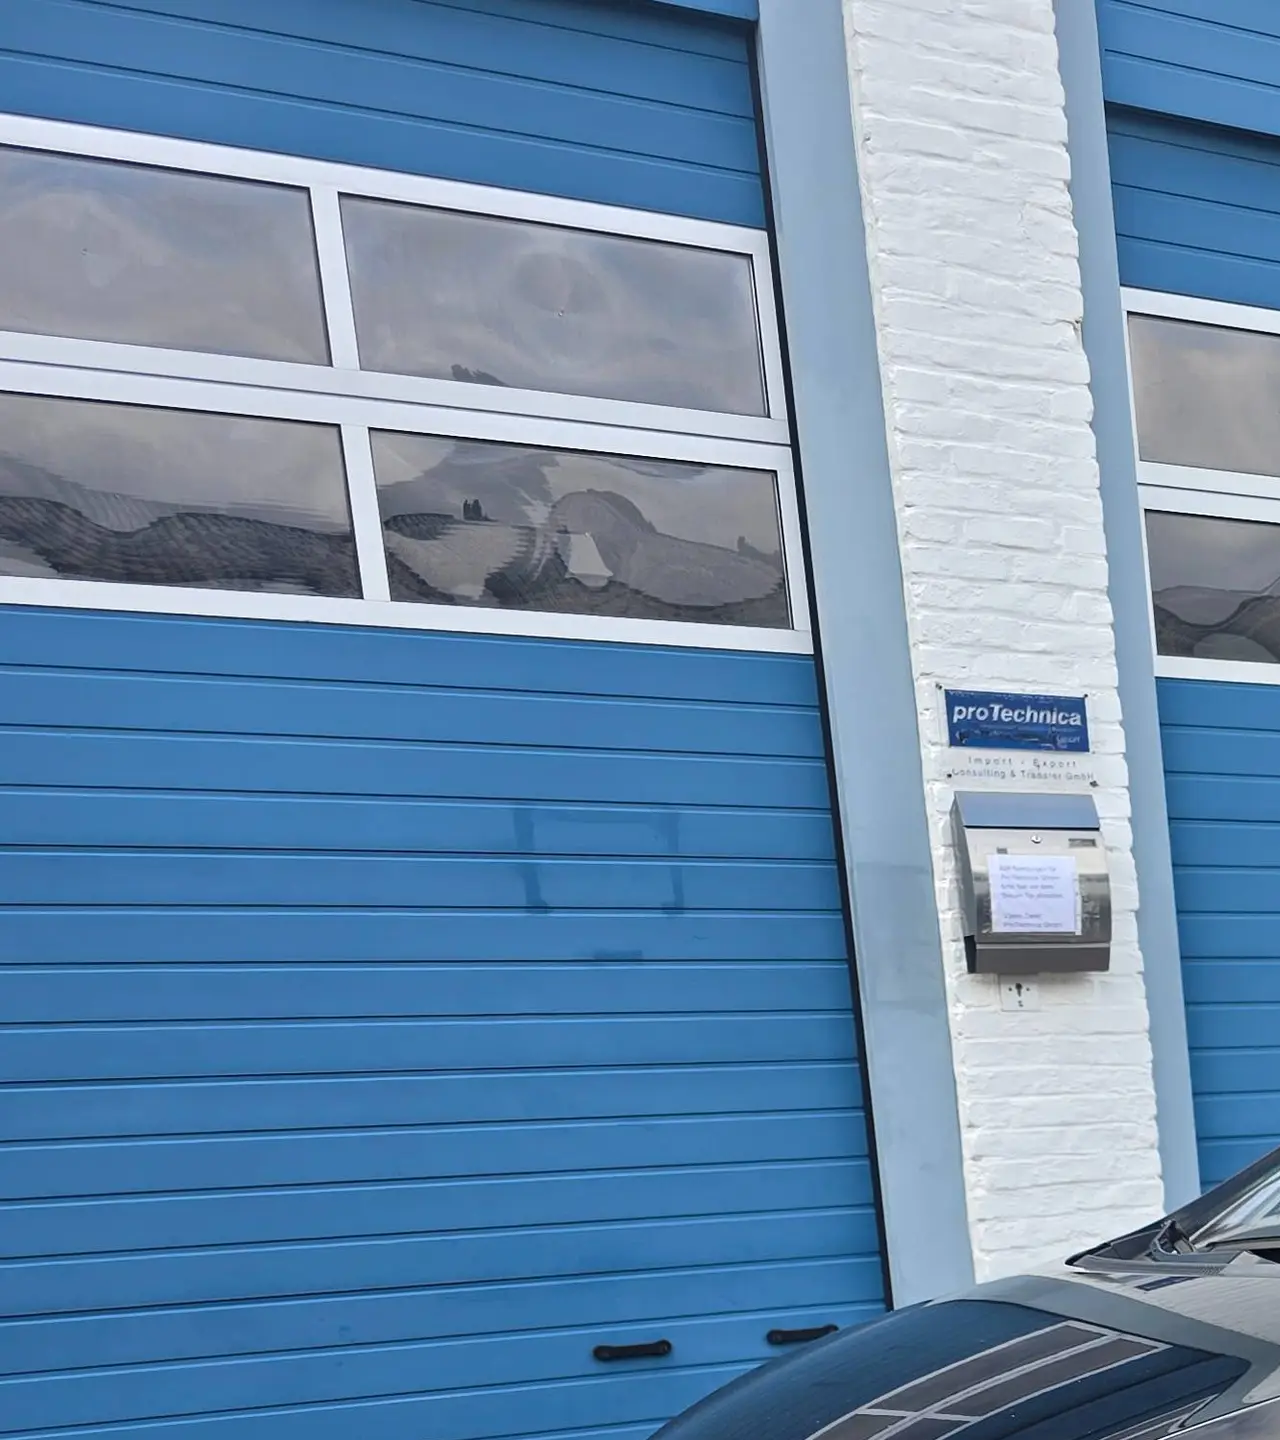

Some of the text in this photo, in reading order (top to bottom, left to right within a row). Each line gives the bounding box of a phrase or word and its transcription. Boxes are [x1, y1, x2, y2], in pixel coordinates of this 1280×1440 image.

[953, 703, 1082, 726] proTechnica
[968, 756, 1012, 766] Import
[1033, 758, 1076, 768] Export
[951, 768, 1006, 780] Consulting
